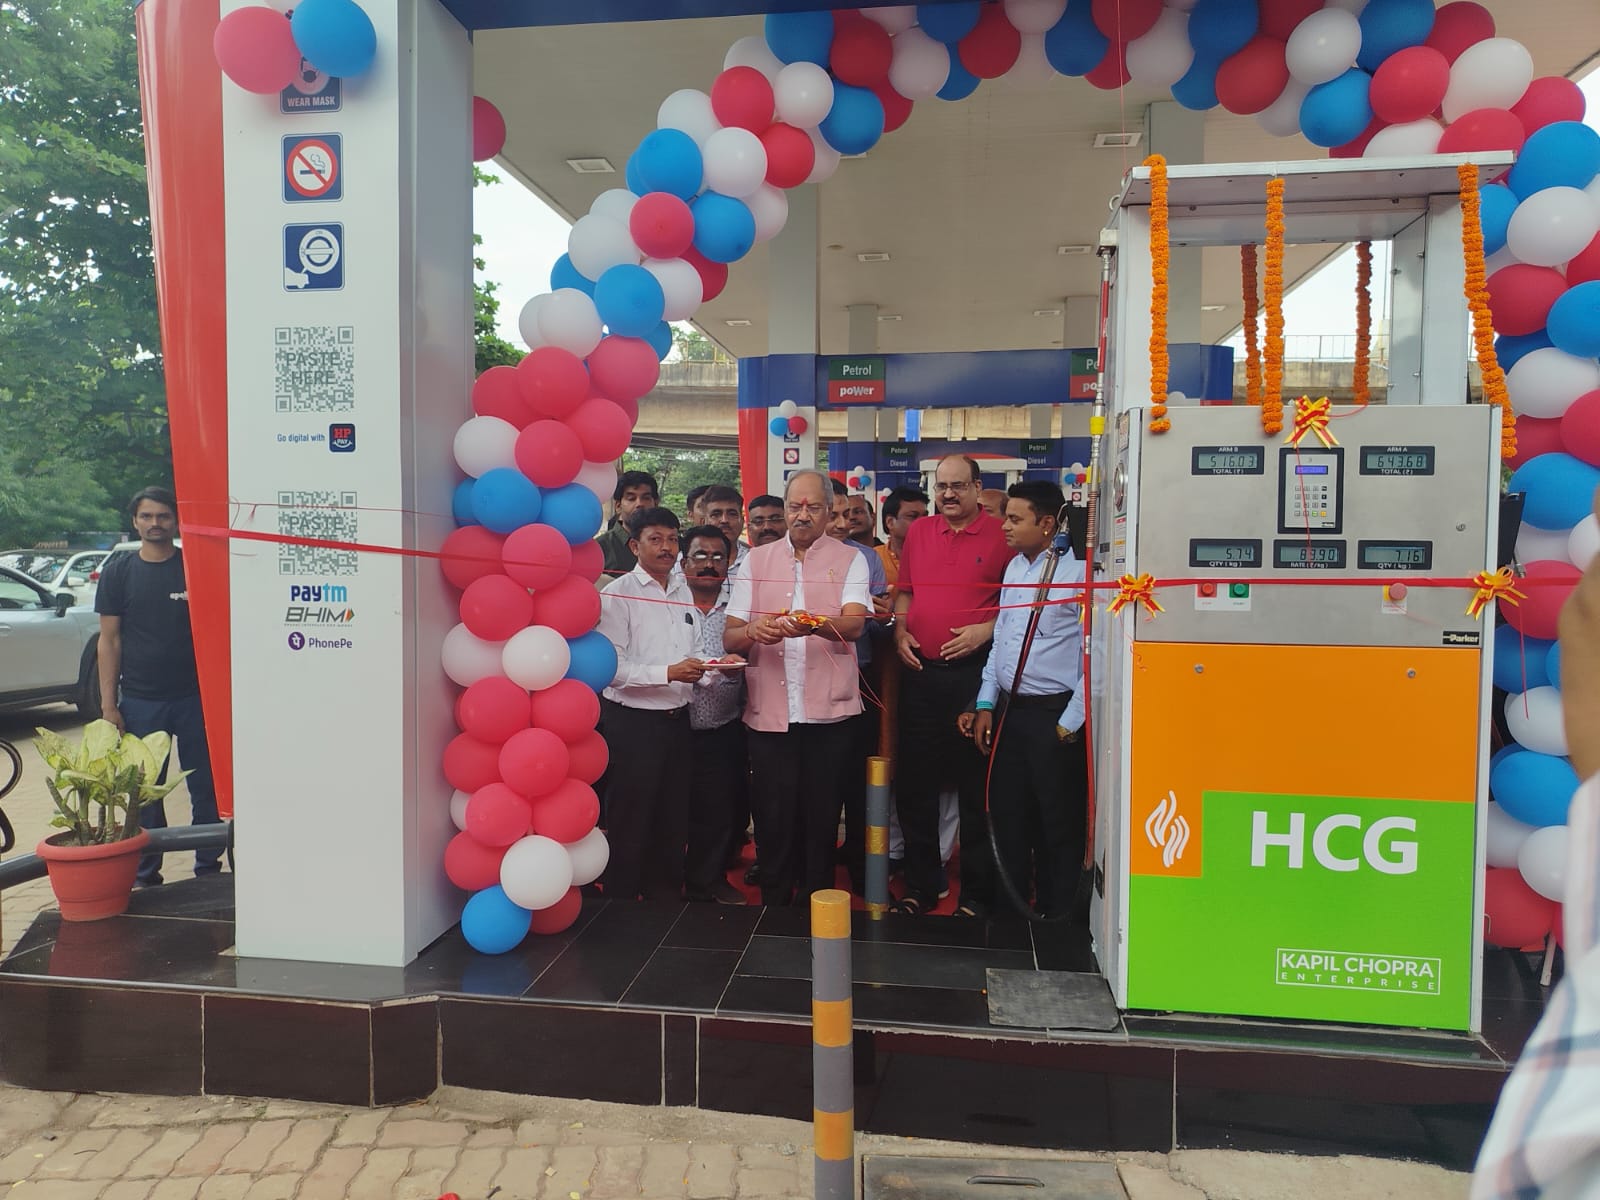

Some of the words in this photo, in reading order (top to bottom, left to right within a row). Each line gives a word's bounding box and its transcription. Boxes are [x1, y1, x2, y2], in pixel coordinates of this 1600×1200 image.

[287, 97, 310, 107] WEAR
[312, 96, 336, 106] MASK
[286, 352, 341, 367] PASTE
[842, 364, 872, 376] Petrol
[291, 370, 338, 385] HERE
[277, 433, 287, 442] Go
[288, 433, 309, 443] digital
[310, 433, 326, 442] with
[333, 427, 352, 438] HP
[889, 459, 908, 467] Diesel
[289, 515, 344, 530] PASTE
[285, 606, 347, 623] BHIM
[308, 637, 353, 649] PhonePe
[1449, 633, 1479, 643] Parker
[1251, 810, 1418, 875] HCG
[1281, 952, 1341, 972] KAPIL
[1343, 957, 1435, 978] CHOPRA
[1281, 971, 1435, 991] ENTERPRISE
